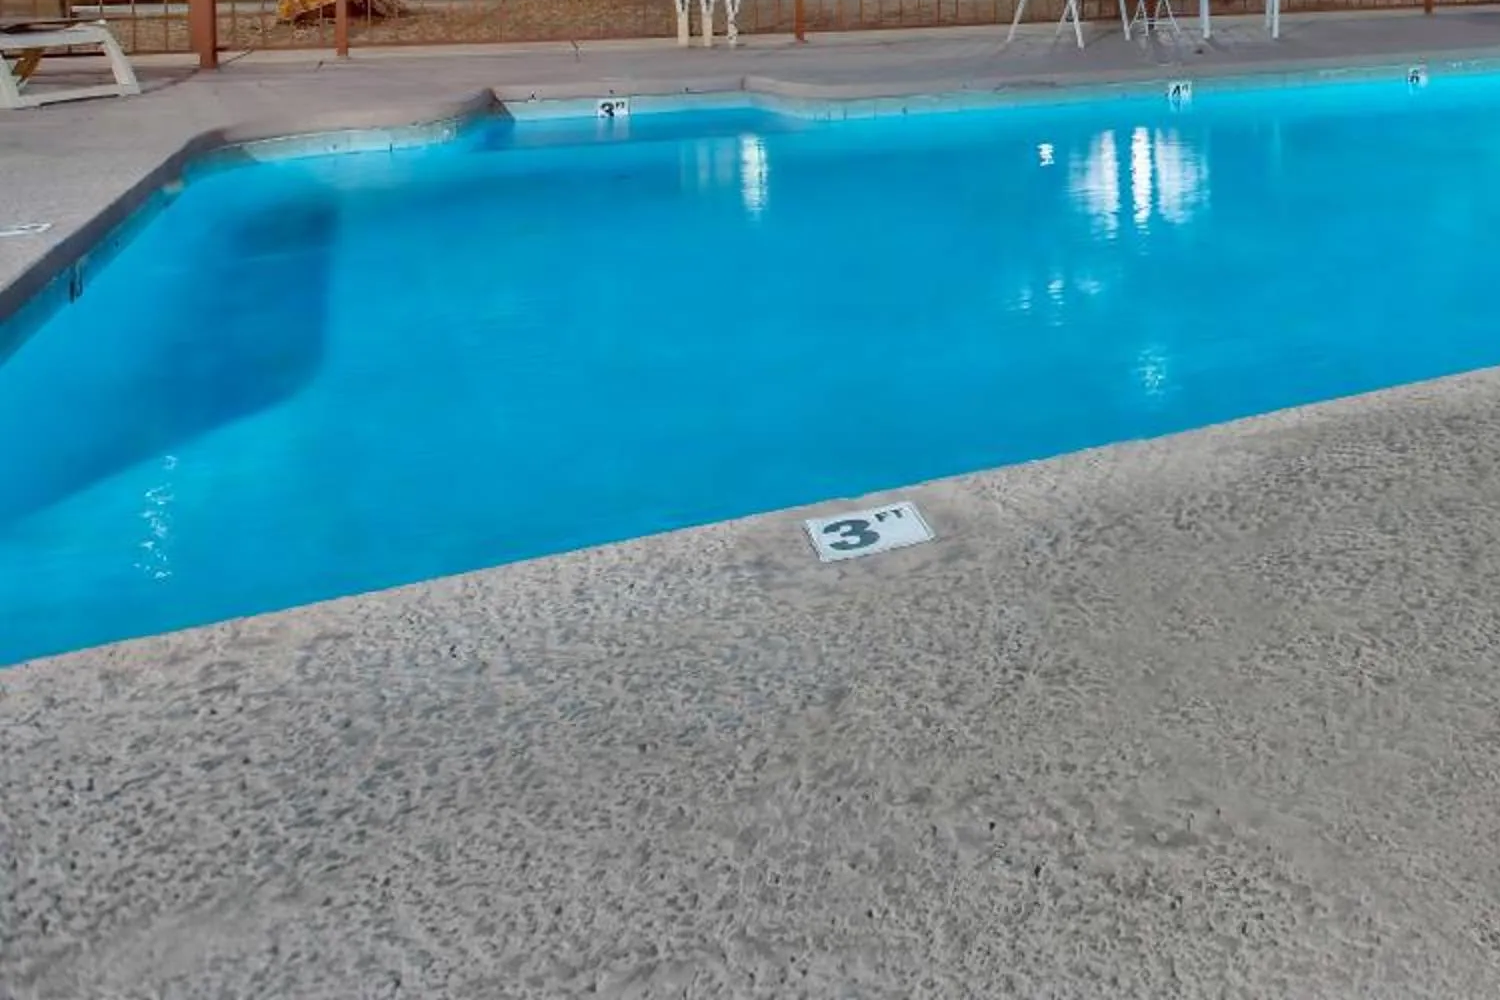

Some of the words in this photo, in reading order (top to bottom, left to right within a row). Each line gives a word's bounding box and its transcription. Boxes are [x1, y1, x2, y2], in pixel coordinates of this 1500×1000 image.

[601, 102, 615, 118] 3
[823, 519, 880, 551] 3
[874, 507, 903, 522] FT
